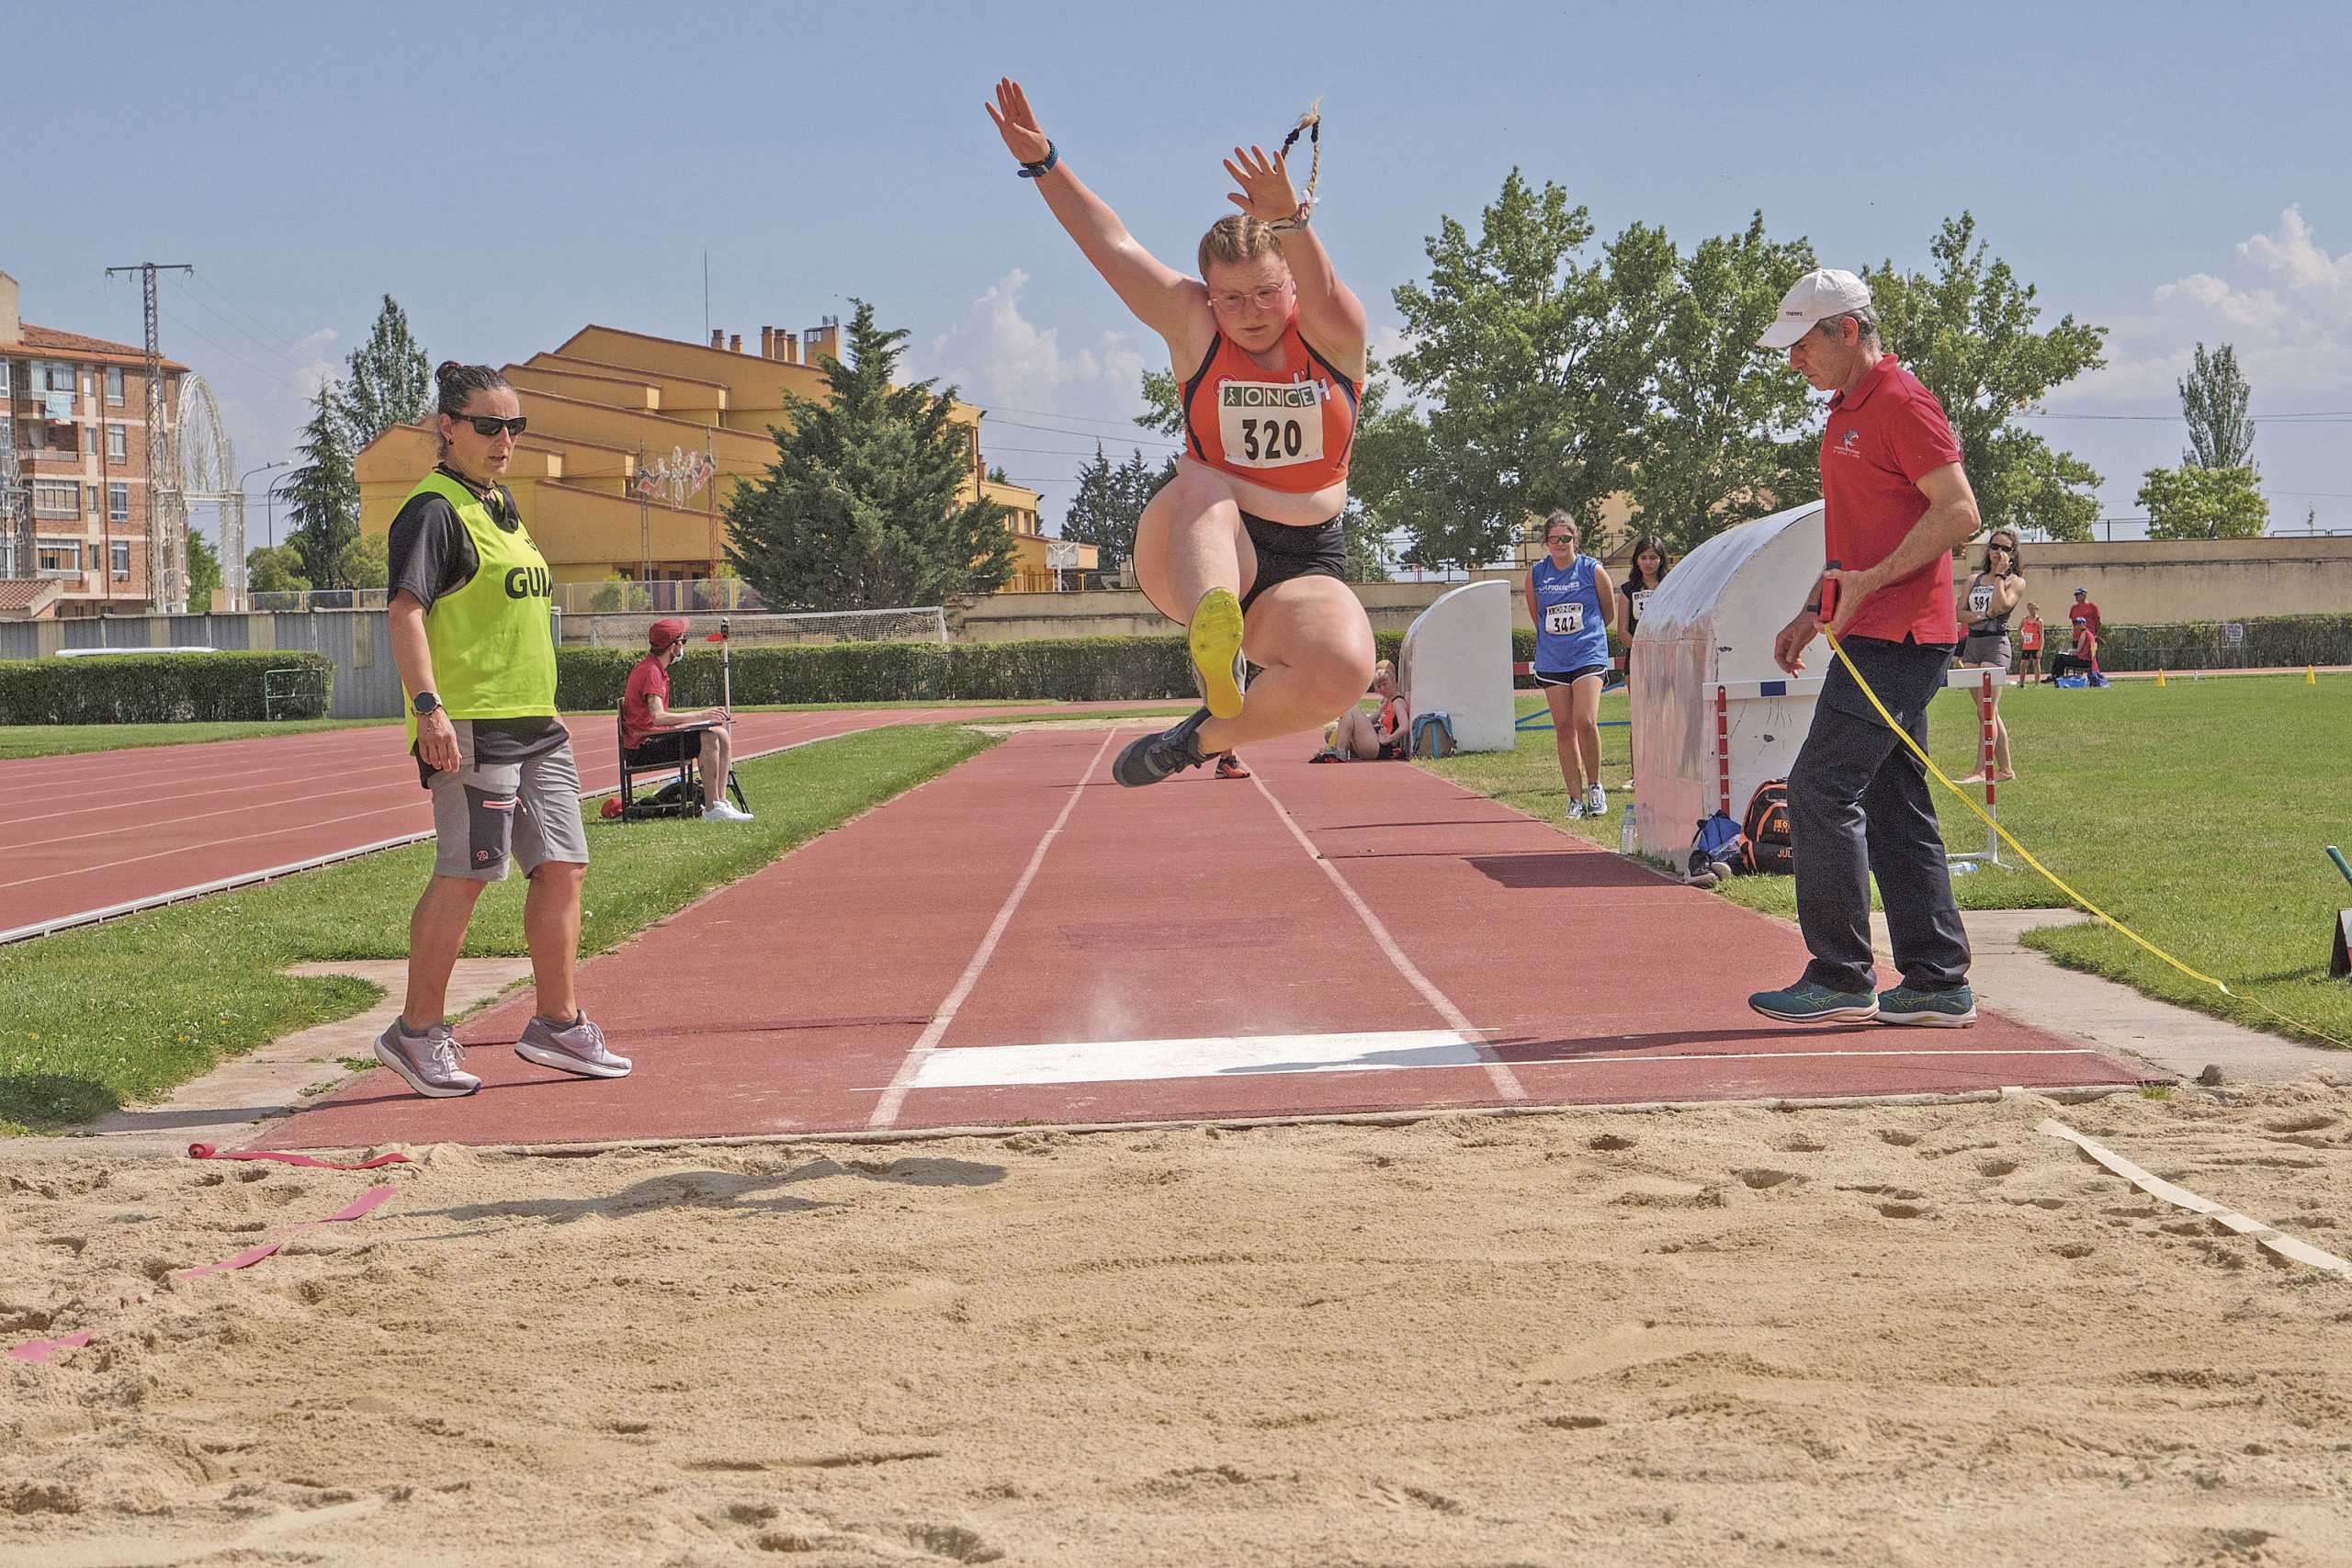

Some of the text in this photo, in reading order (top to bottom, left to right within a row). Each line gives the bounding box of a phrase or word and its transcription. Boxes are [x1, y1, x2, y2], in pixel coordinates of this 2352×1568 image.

[1245, 387, 1315, 407] ONCE
[1242, 419, 1302, 460] 320
[1555, 604, 1581, 614] ONCE
[1973, 595, 1990, 612] 381
[1554, 616, 1576, 632] 342
